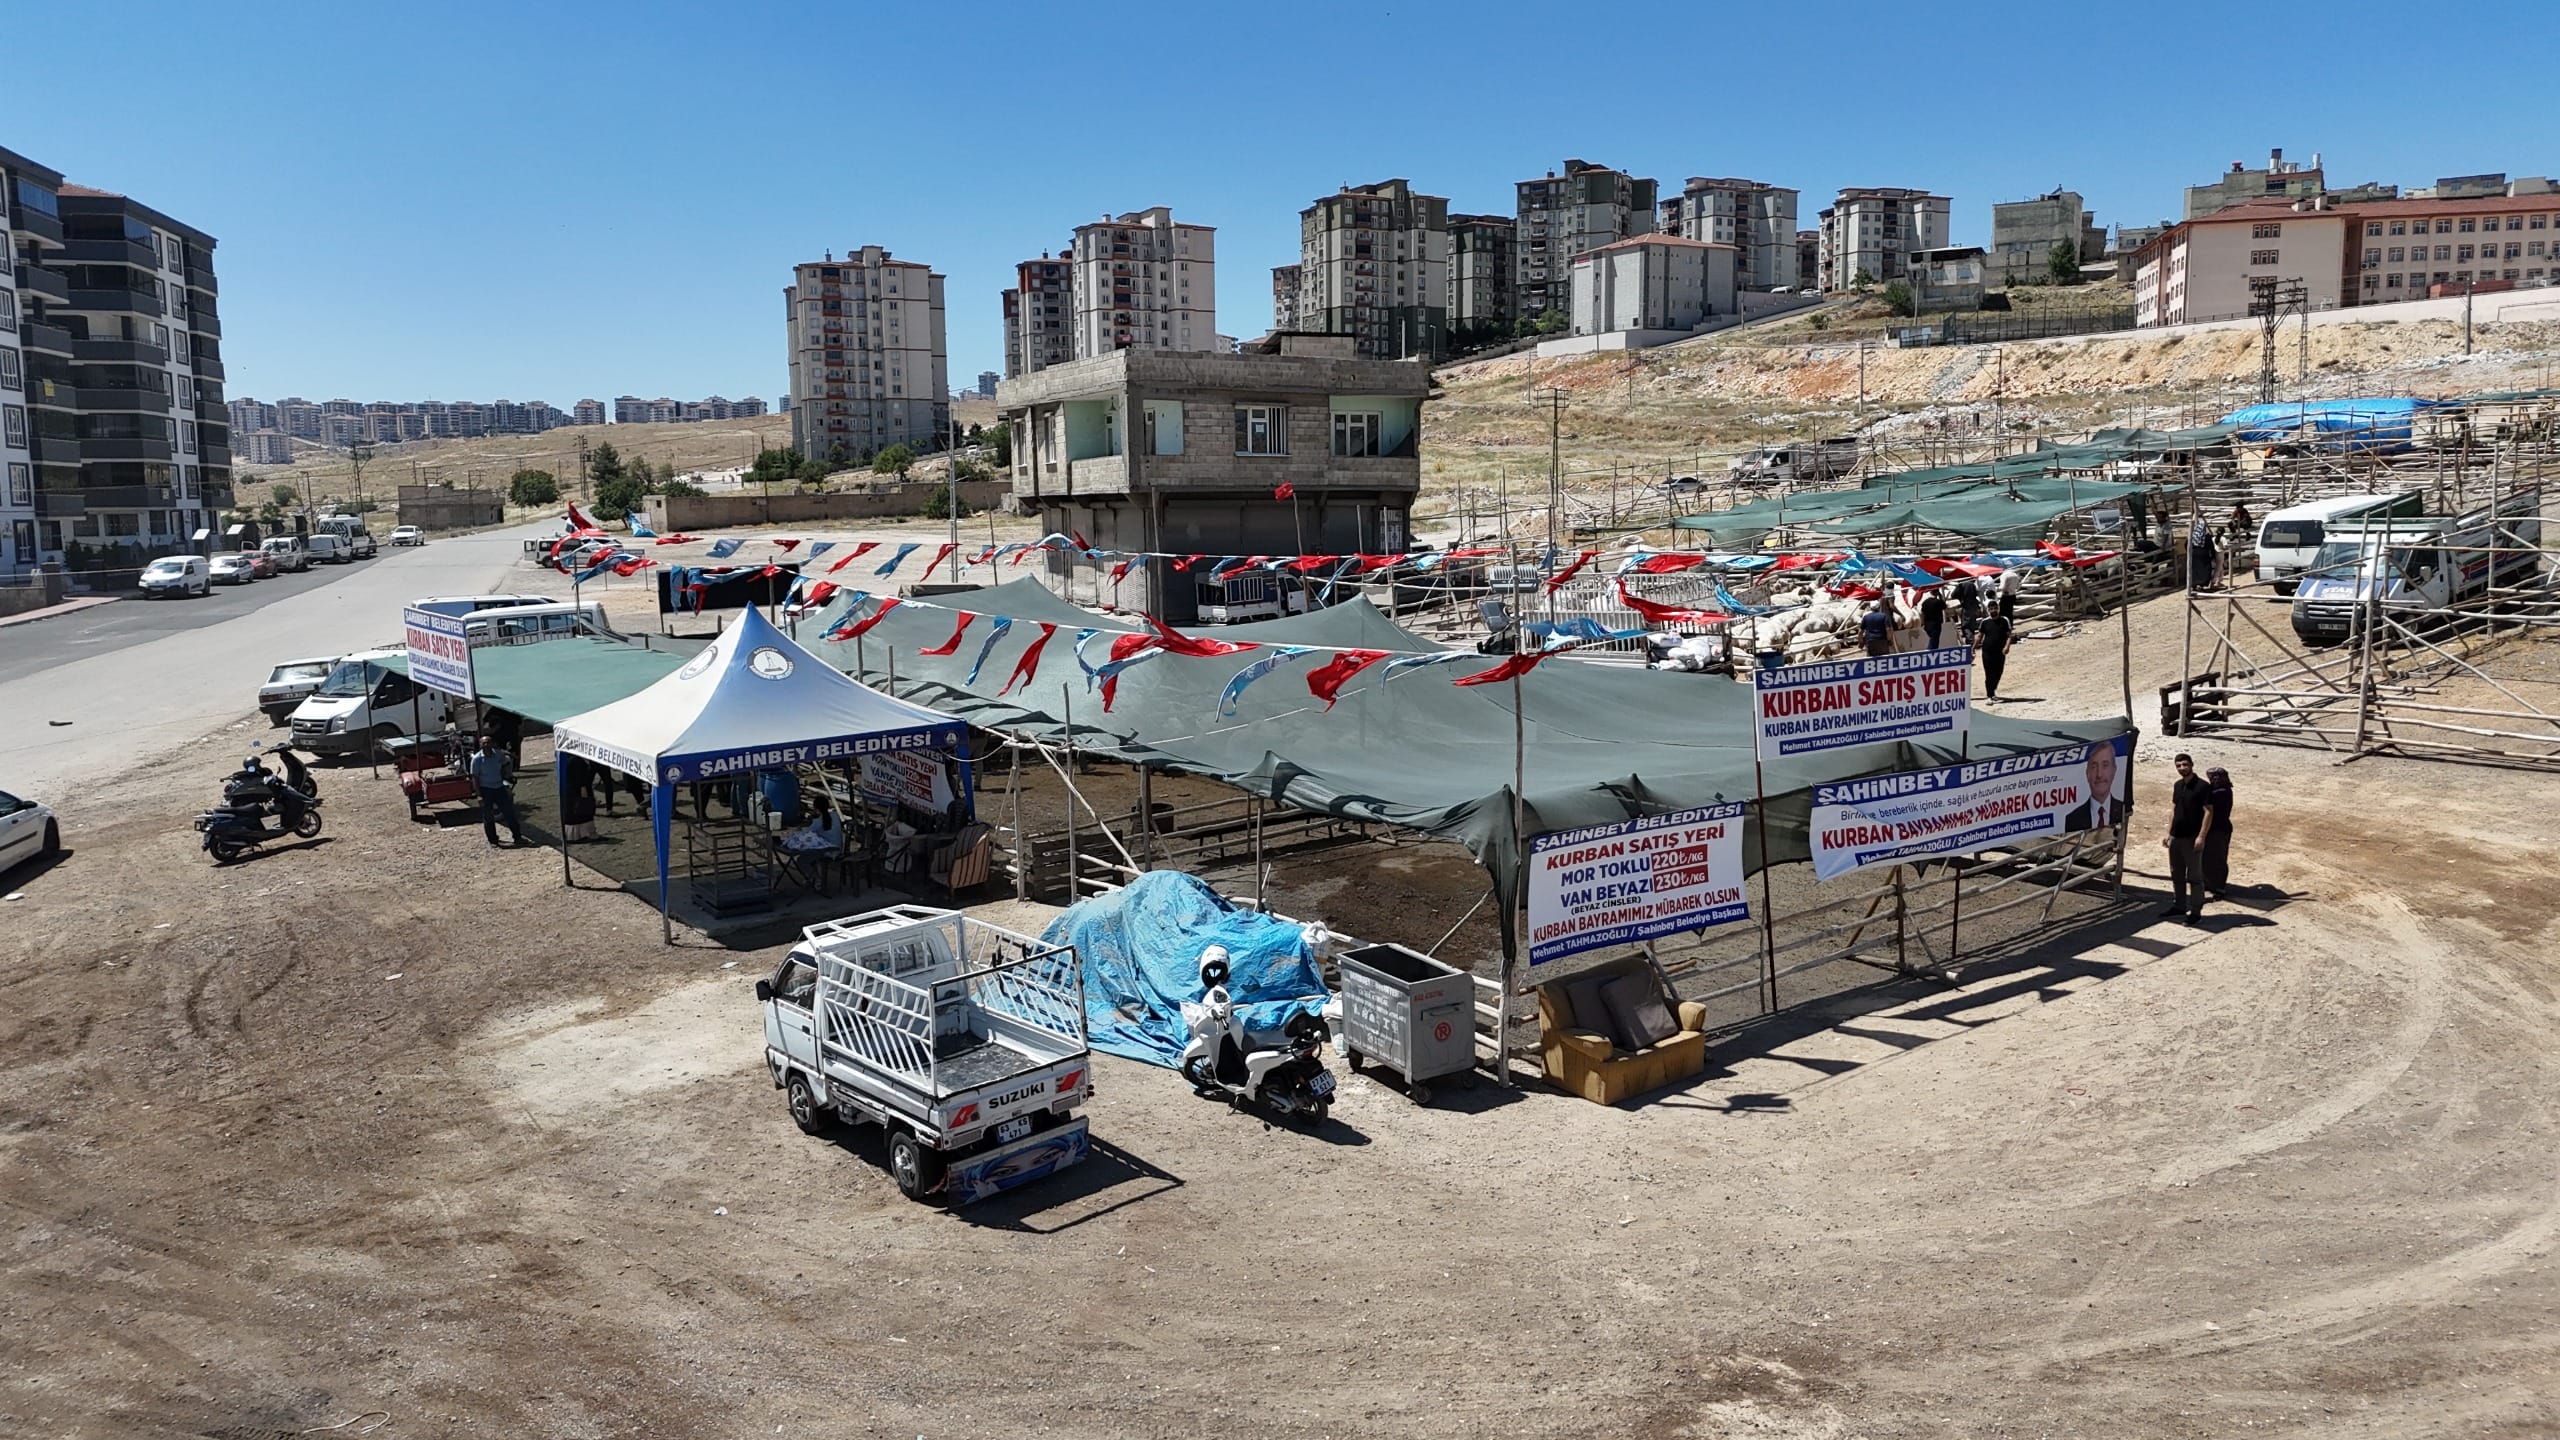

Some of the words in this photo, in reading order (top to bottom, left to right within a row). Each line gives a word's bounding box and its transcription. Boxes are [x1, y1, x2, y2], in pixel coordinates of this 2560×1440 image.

[407, 627, 431, 653] KURBAN
[449, 638, 466, 663] YERİ
[1761, 662, 1858, 688] ŞAHİNBEY
[1864, 649, 1967, 675] BELEDİYESİ
[1762, 684, 1851, 718] KURBAN
[1858, 675, 1916, 706] SATIŞ
[1920, 669, 1966, 697] YERİ
[1765, 719, 1810, 738] KURBAN
[1812, 710, 1879, 732] BAYRAMIMIZ
[1880, 702, 1930, 722] MÜBAREK
[1932, 697, 1966, 714] OLSUN
[1782, 740, 1811, 752] Mehmet
[1811, 734, 1859, 748] TAHMAZOĞLU
[1864, 729, 1895, 741] Şahinbey
[1896, 725, 1924, 736] Belediye
[1924, 720, 1950, 731] Başkanı
[597, 746, 642, 776] BELEDİYESİ
[700, 746, 809, 777] ŞAHİNBEY
[816, 731, 932, 758] BELEDİYESİ
[1817, 769, 1952, 806] ŞAHİNBEY
[1960, 745, 2089, 785] BELEDİYESİ
[1821, 824, 1895, 850] KURBAN
[1895, 808, 1974, 841] BAYRAMIMIZ
[1975, 793, 2031, 824] MÜBAREK
[2032, 785, 2078, 810] OLSUN
[1840, 810, 1868, 821] Birlik
[1878, 804, 1919, 818] bereberlik
[1977, 784, 2002, 799] huzurla
[2002, 782, 2018, 792] nice
[1535, 821, 1633, 852] ŞAHİNBEY
[1636, 803, 1742, 831] BELEDİYESİ
[1546, 841, 1625, 871] KURBAN
[1628, 832, 1680, 854] SATIŞ
[1684, 822, 1725, 844] YERİ
[1957, 831, 1988, 847] Şahinbey
[1988, 822, 2020, 838] Belediye
[2020, 818, 2051, 830] Başkanı
[1560, 868, 1596, 887] MOR
[1599, 857, 1650, 879] TOKLU
[1560, 888, 1593, 908] VAN
[1596, 878, 1654, 900] BEYAZI
[1570, 902, 1601, 916] (BEYAZ
[1602, 895, 1642, 909] CİNSLER)
[1532, 941, 1565, 960] Mehmet
[1566, 927, 1628, 950] TAHMAZOĞLU
[1637, 921, 1675, 937] Şahinbey
[1677, 910, 1711, 925] Belediye
[1711, 906, 1745, 920] Başkanı
[1533, 922, 1576, 944] KURBAN
[1578, 905, 1654, 933] BAYRAMIMIZ
[1655, 896, 1703, 918] MÜBAREK
[1704, 887, 1740, 905] OLSUN
[988, 1082, 1045, 1109] SUZUKI
